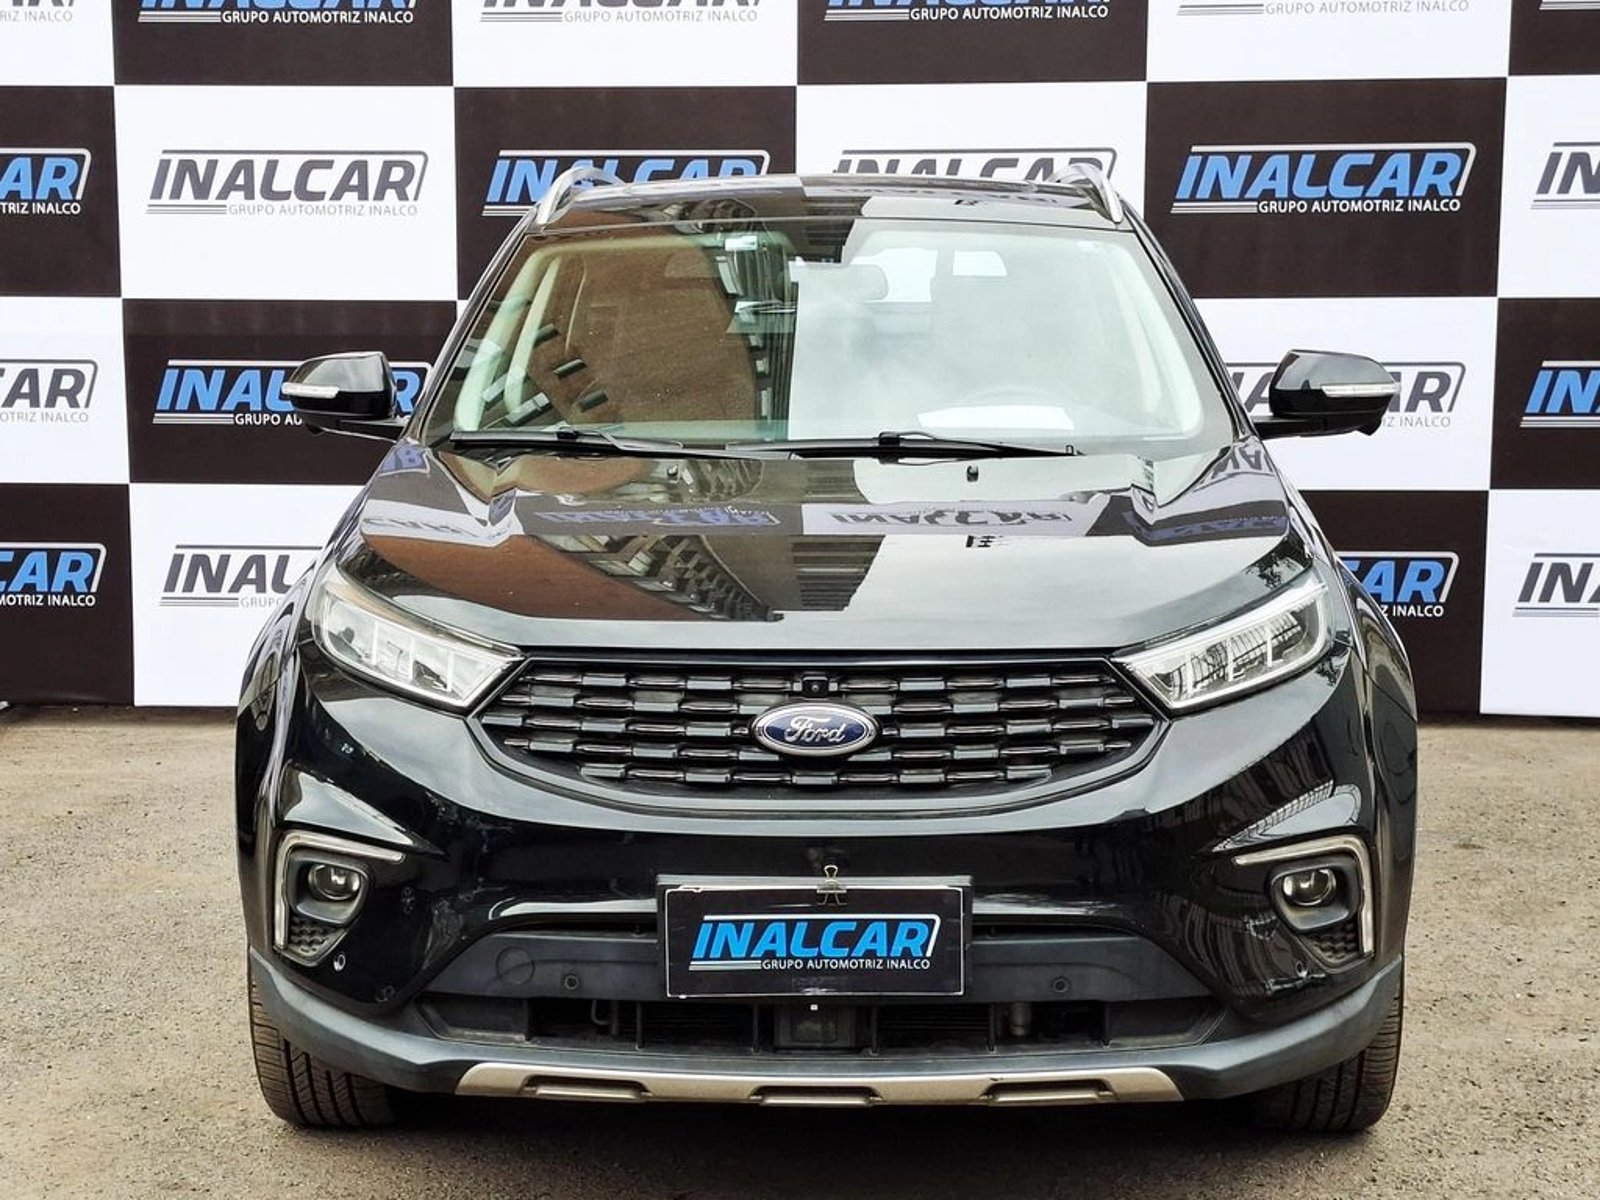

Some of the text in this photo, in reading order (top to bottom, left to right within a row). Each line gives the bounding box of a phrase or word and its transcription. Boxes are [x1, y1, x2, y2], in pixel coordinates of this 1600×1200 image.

[909, 7, 1109, 20] GRUPO AUTOMOTRIZ INALCO
[1264, 0, 1469, 15] GRUPO AUTOMOTRIZ INALCO
[25, 11, 73, 22] INALCO
[222, 11, 414, 23] GRUPO AUTOMOTRIZ INALCO
[563, 10, 757, 22] GRUPO AUTOMOTRIZ INALCO
[149, 158, 415, 201] INALCAR
[1175, 152, 1462, 199] INALCAR
[32, 202, 81, 215] INALCO
[229, 204, 418, 217] GRUPO AUTOMOTRIZ INALCO
[1258, 199, 1461, 213] GRUPO AUTOMOTRIZ INALCO
[156, 369, 420, 412] INALR
[40, 412, 89, 423] INALCO
[235, 413, 279, 426] GRUPO
[1398, 416, 1452, 428] INALCO
[163, 553, 295, 594] INAL
[0, 593, 96, 607] MOTRIZ INALCO
[1391, 604, 1444, 618] INALCO
[783, 715, 846, 742] Ford
[692, 921, 928, 959] INALCAR
[761, 958, 931, 971] GRUPO AUTOMOTRIZ INALCO
